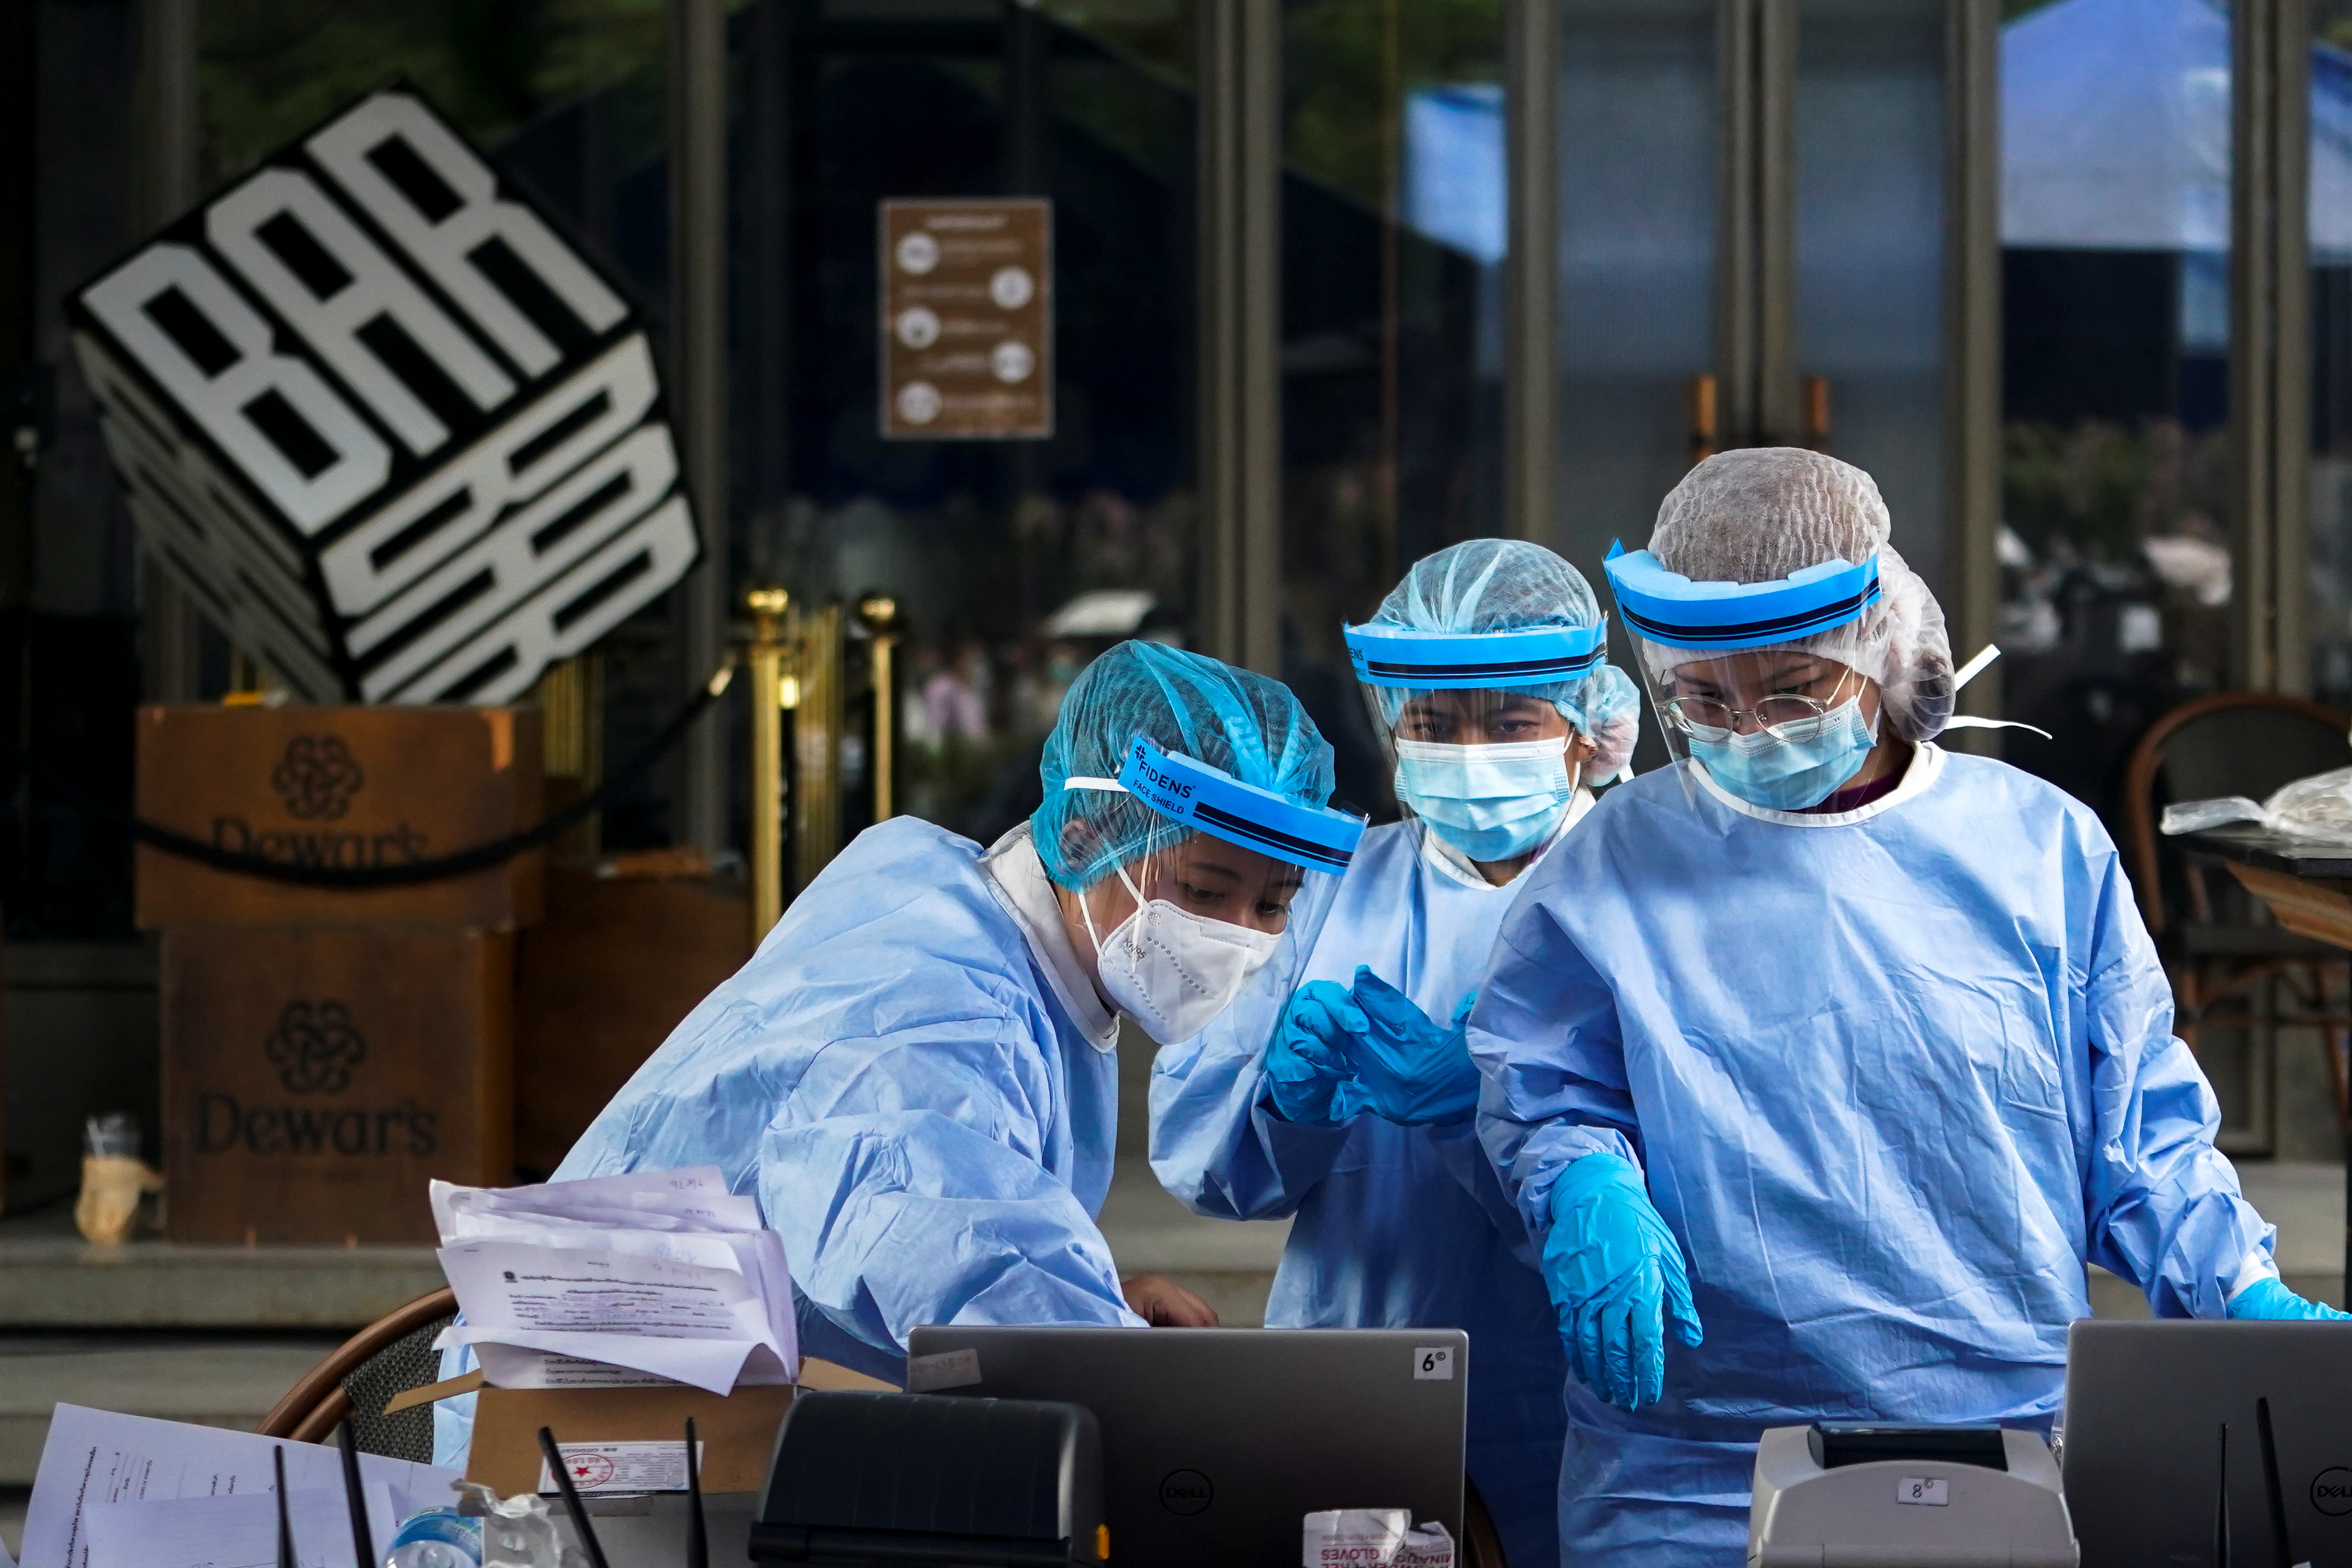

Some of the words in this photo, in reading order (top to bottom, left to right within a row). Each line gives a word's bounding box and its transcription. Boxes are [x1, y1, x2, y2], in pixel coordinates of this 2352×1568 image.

[80, 92, 630, 536] BAR
[1133, 779, 1151, 798] FACE
[1151, 794, 1185, 815] SHIELD
[1138, 760, 1193, 799] FIDENS
[211, 817, 428, 867] Dewar's
[193, 1091, 437, 1158] Dewar's
[1167, 1486, 1208, 1498] DELL
[1321, 1548, 1380, 1561] GLOVES
